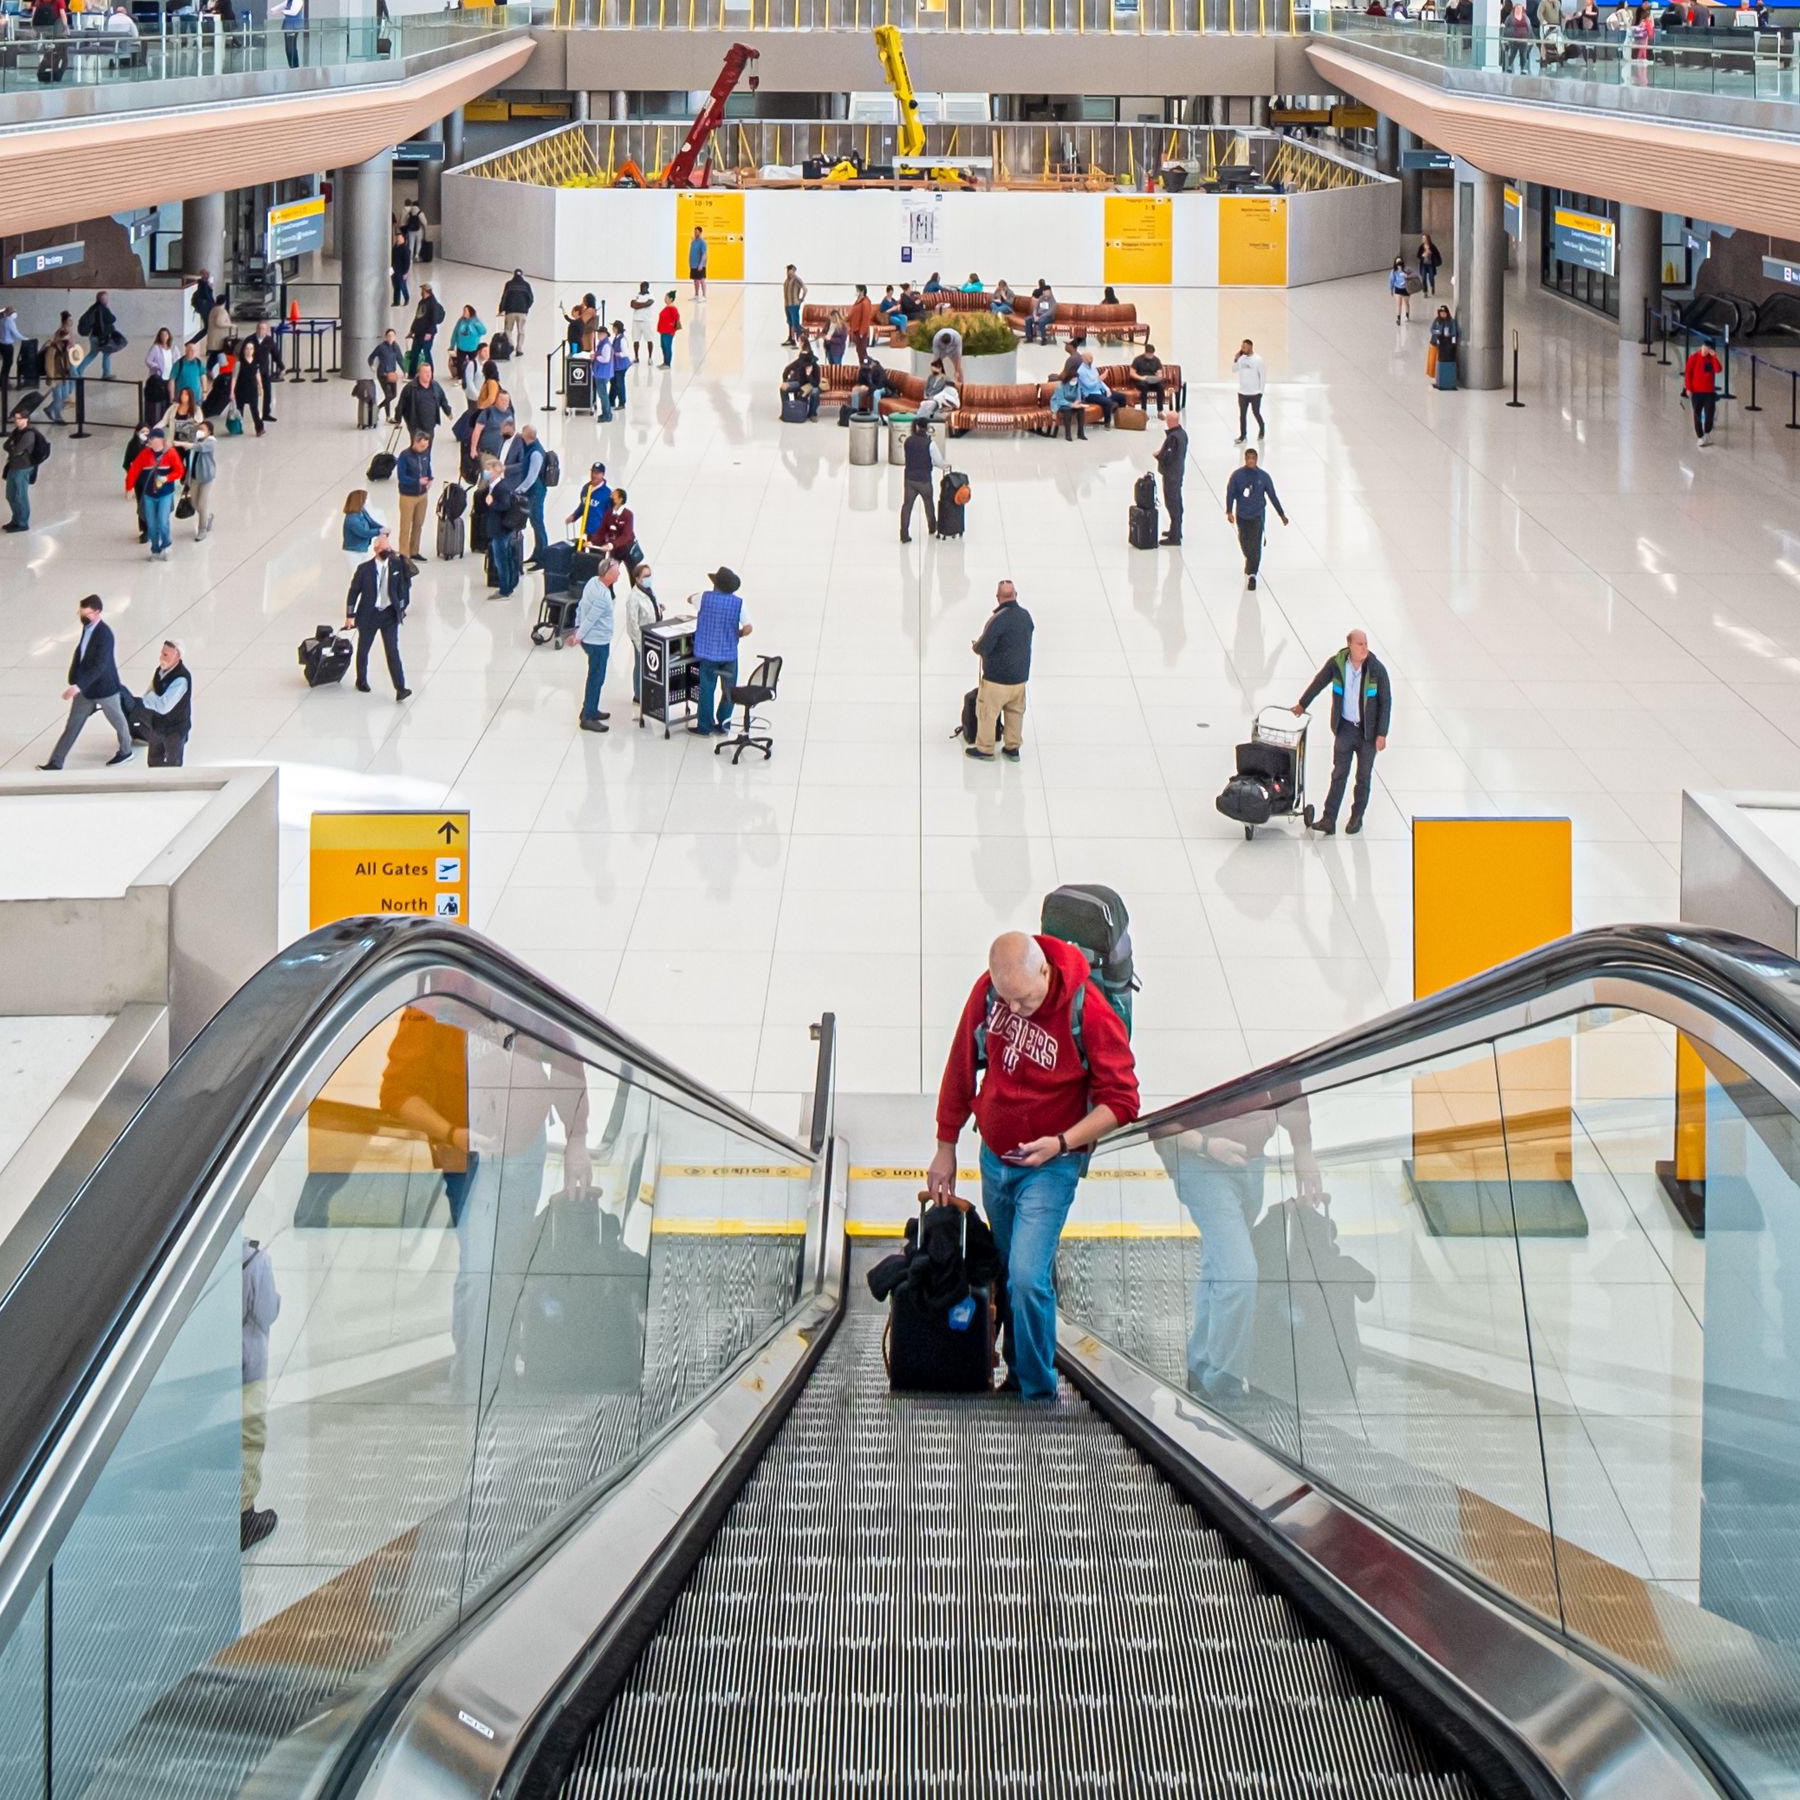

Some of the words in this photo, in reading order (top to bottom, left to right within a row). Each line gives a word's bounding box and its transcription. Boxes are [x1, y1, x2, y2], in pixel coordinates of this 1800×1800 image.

[355, 862, 376, 876] All
[382, 862, 429, 876] Gates
[381, 898, 428, 912] North
[893, 1170, 929, 1178] tion
